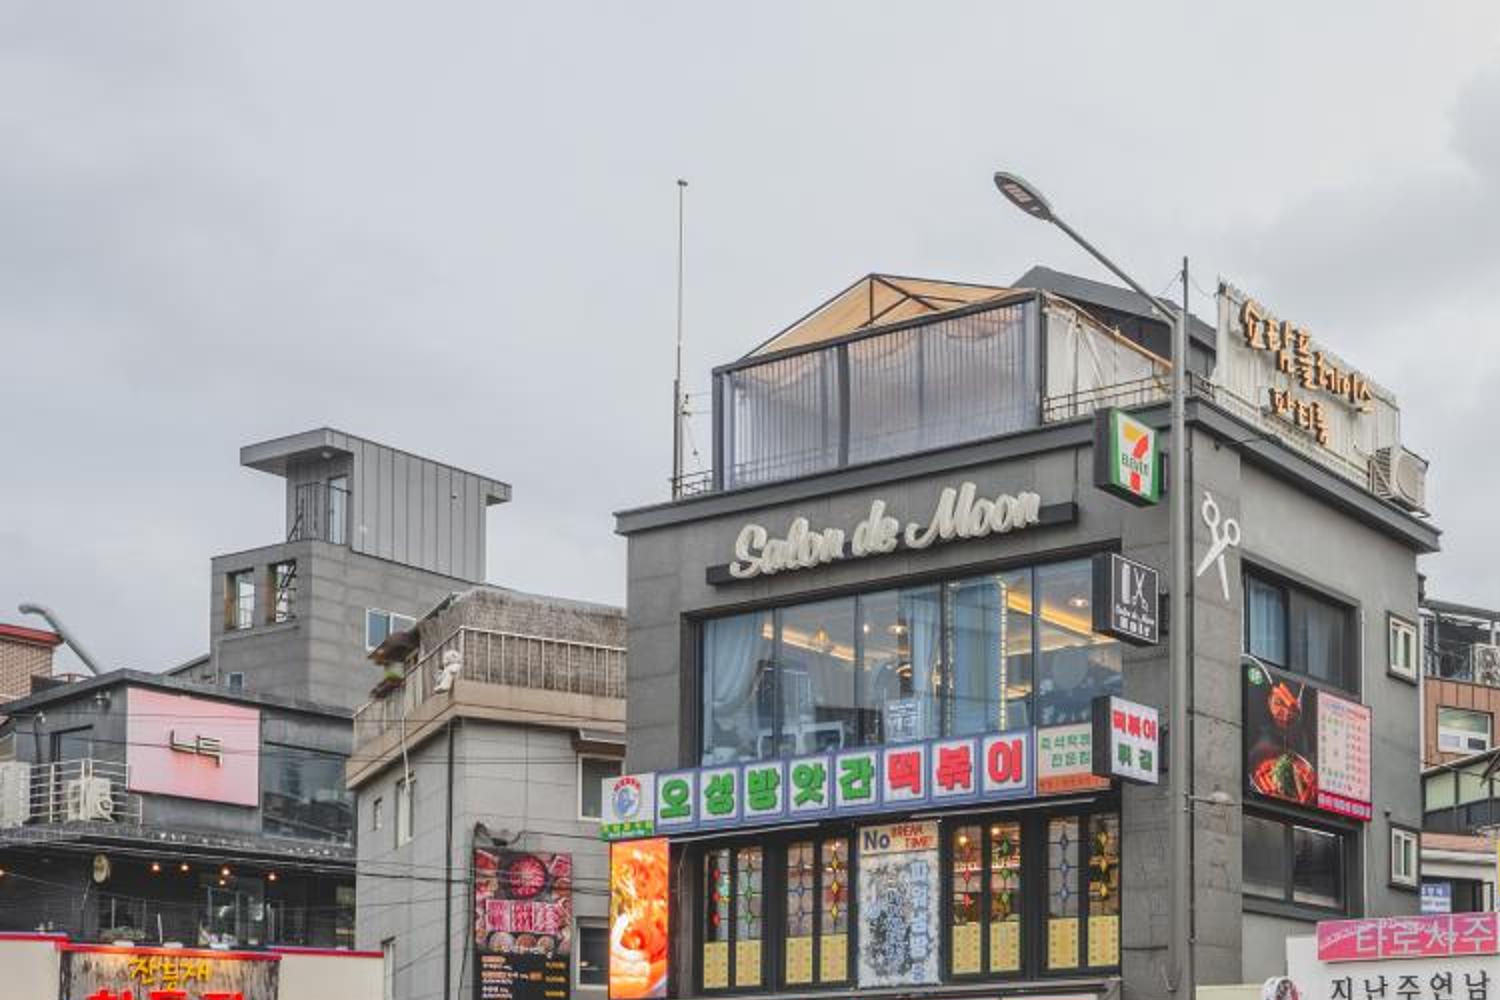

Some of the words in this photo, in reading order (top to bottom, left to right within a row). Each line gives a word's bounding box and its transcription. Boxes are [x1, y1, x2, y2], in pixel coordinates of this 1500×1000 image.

[730, 516, 846, 579] Salon
[852, 500, 898, 553] de
[905, 482, 1041, 548] Moon
[659, 757, 876, 819] 오성방앗간
[887, 739, 1024, 797] 떡볶이
[864, 830, 890, 851] No
[1356, 917, 1494, 956] 타로사주
